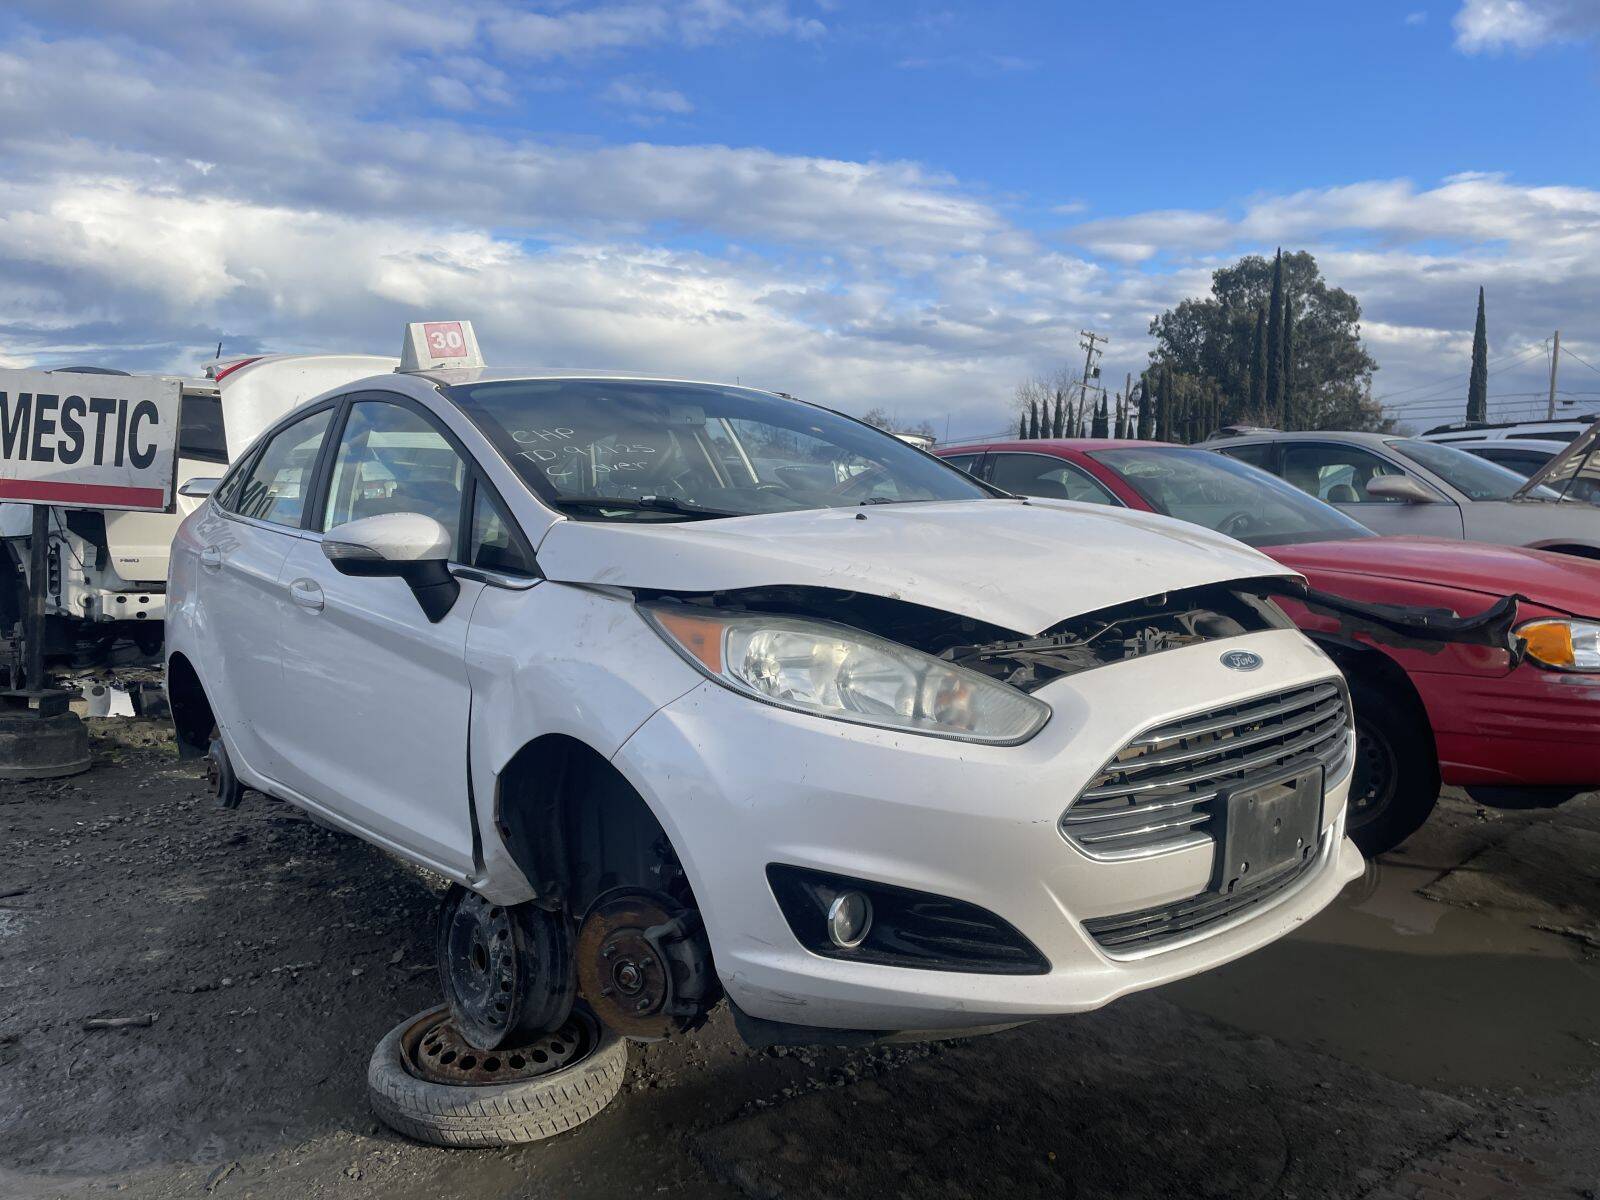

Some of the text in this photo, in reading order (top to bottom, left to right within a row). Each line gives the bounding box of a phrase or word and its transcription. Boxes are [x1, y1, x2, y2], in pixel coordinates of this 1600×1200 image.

[431, 331, 461, 349] 30
[0, 391, 159, 469] MESTIC
[512, 427, 574, 444] CHP
[1230, 653, 1256, 667] Ford
